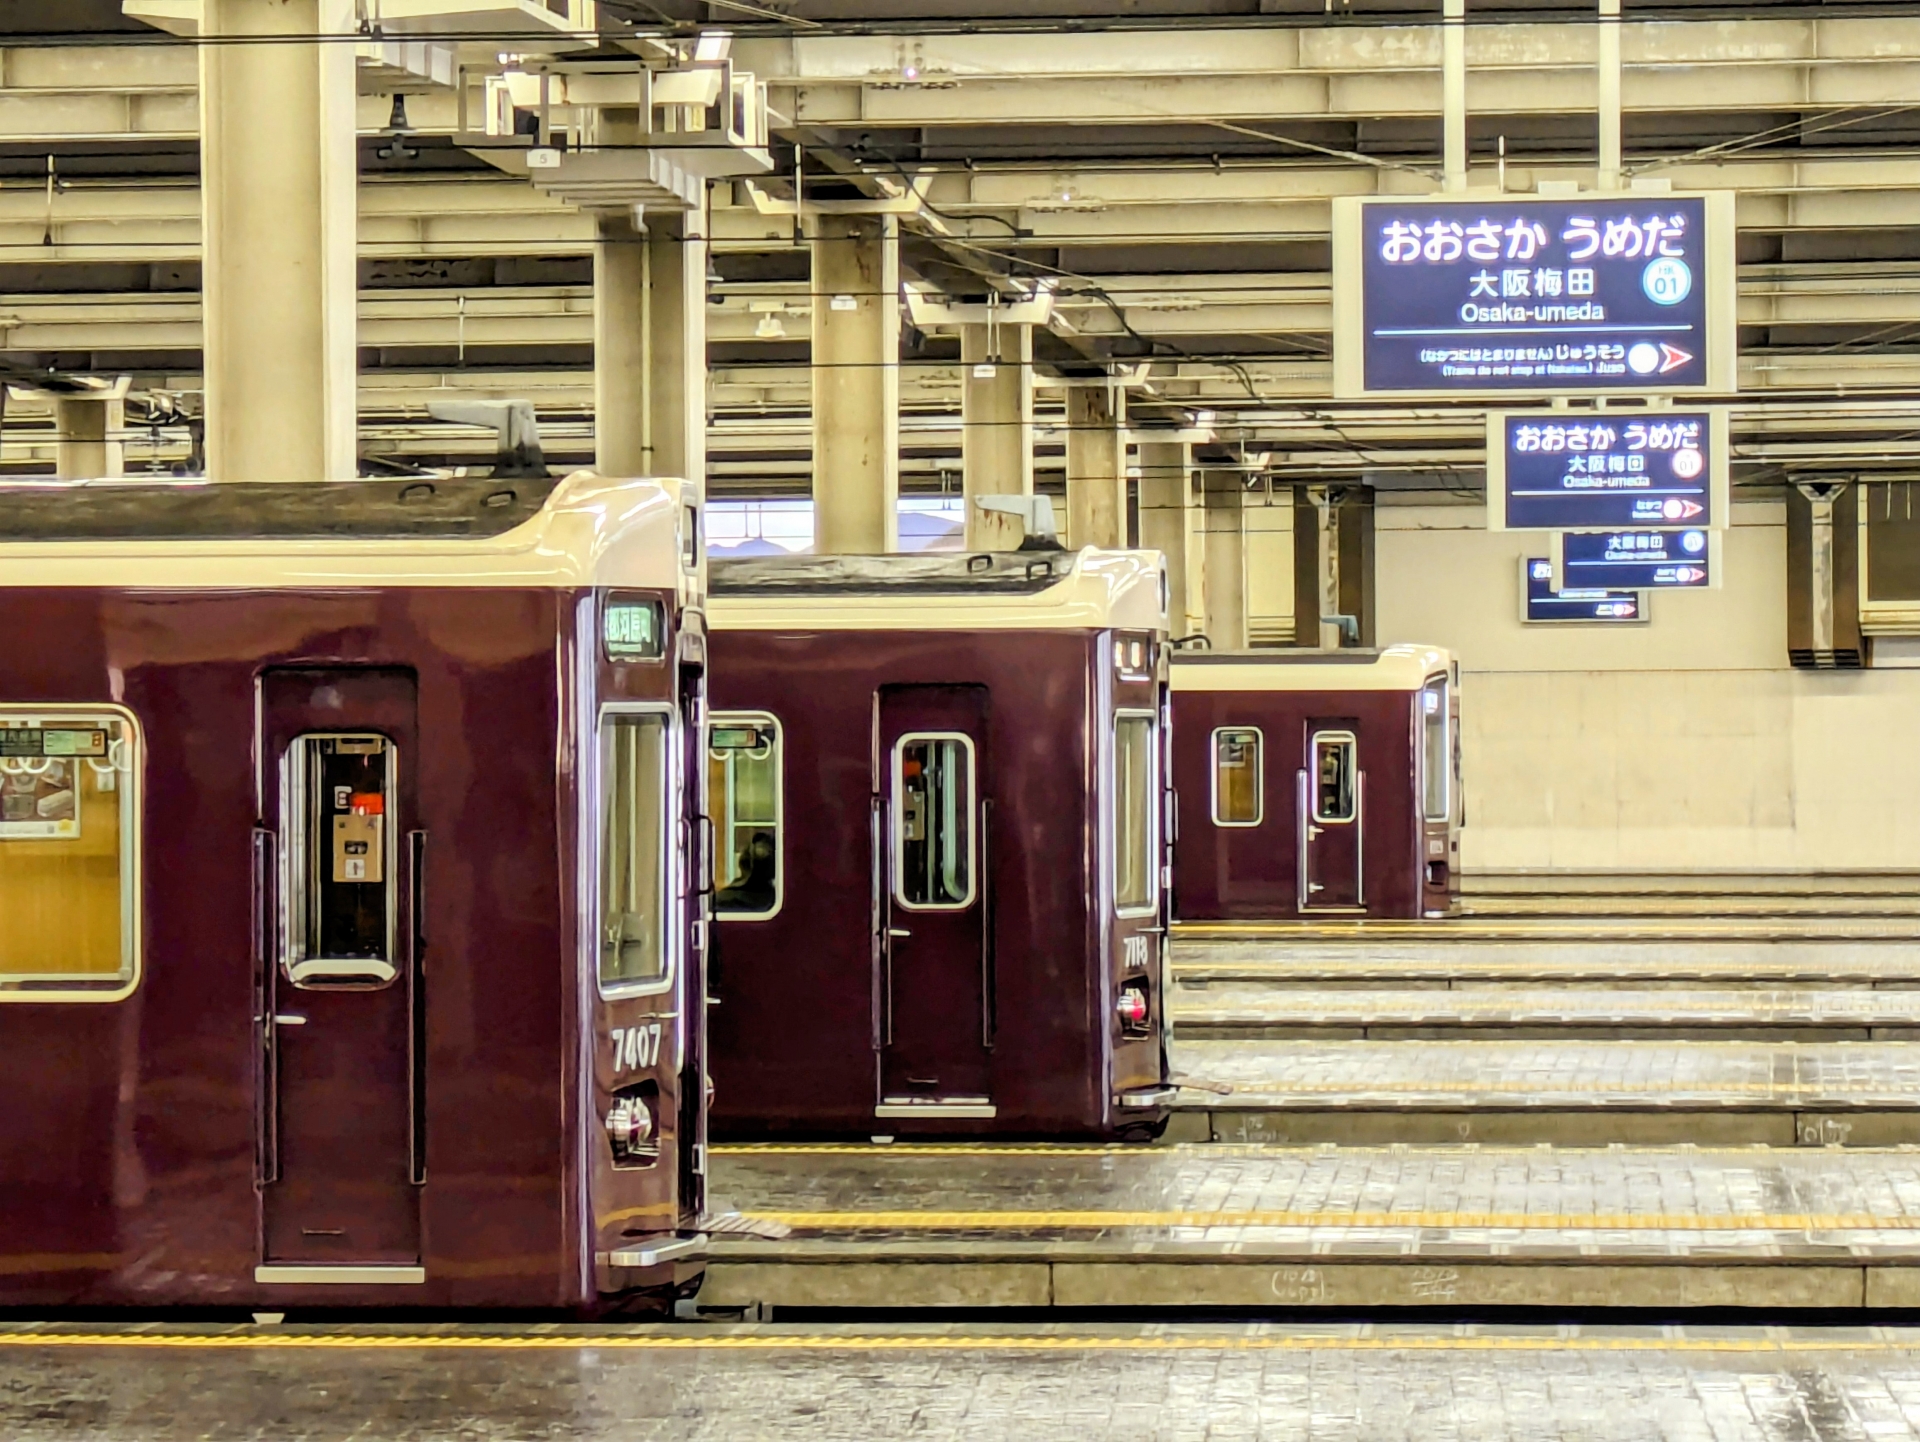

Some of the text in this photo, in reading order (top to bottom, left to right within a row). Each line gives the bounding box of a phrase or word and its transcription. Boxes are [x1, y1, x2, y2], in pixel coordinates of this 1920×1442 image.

[1382, 215, 1684, 261] おおさか うめだ
[1470, 268, 1595, 298] 大阪梅田
[1654, 277, 1677, 295] 01
[1461, 301, 1605, 322] Osaka-umeda
[1516, 422, 1699, 450] おおさか うめだ
[612, 1023, 662, 1073] 7407
